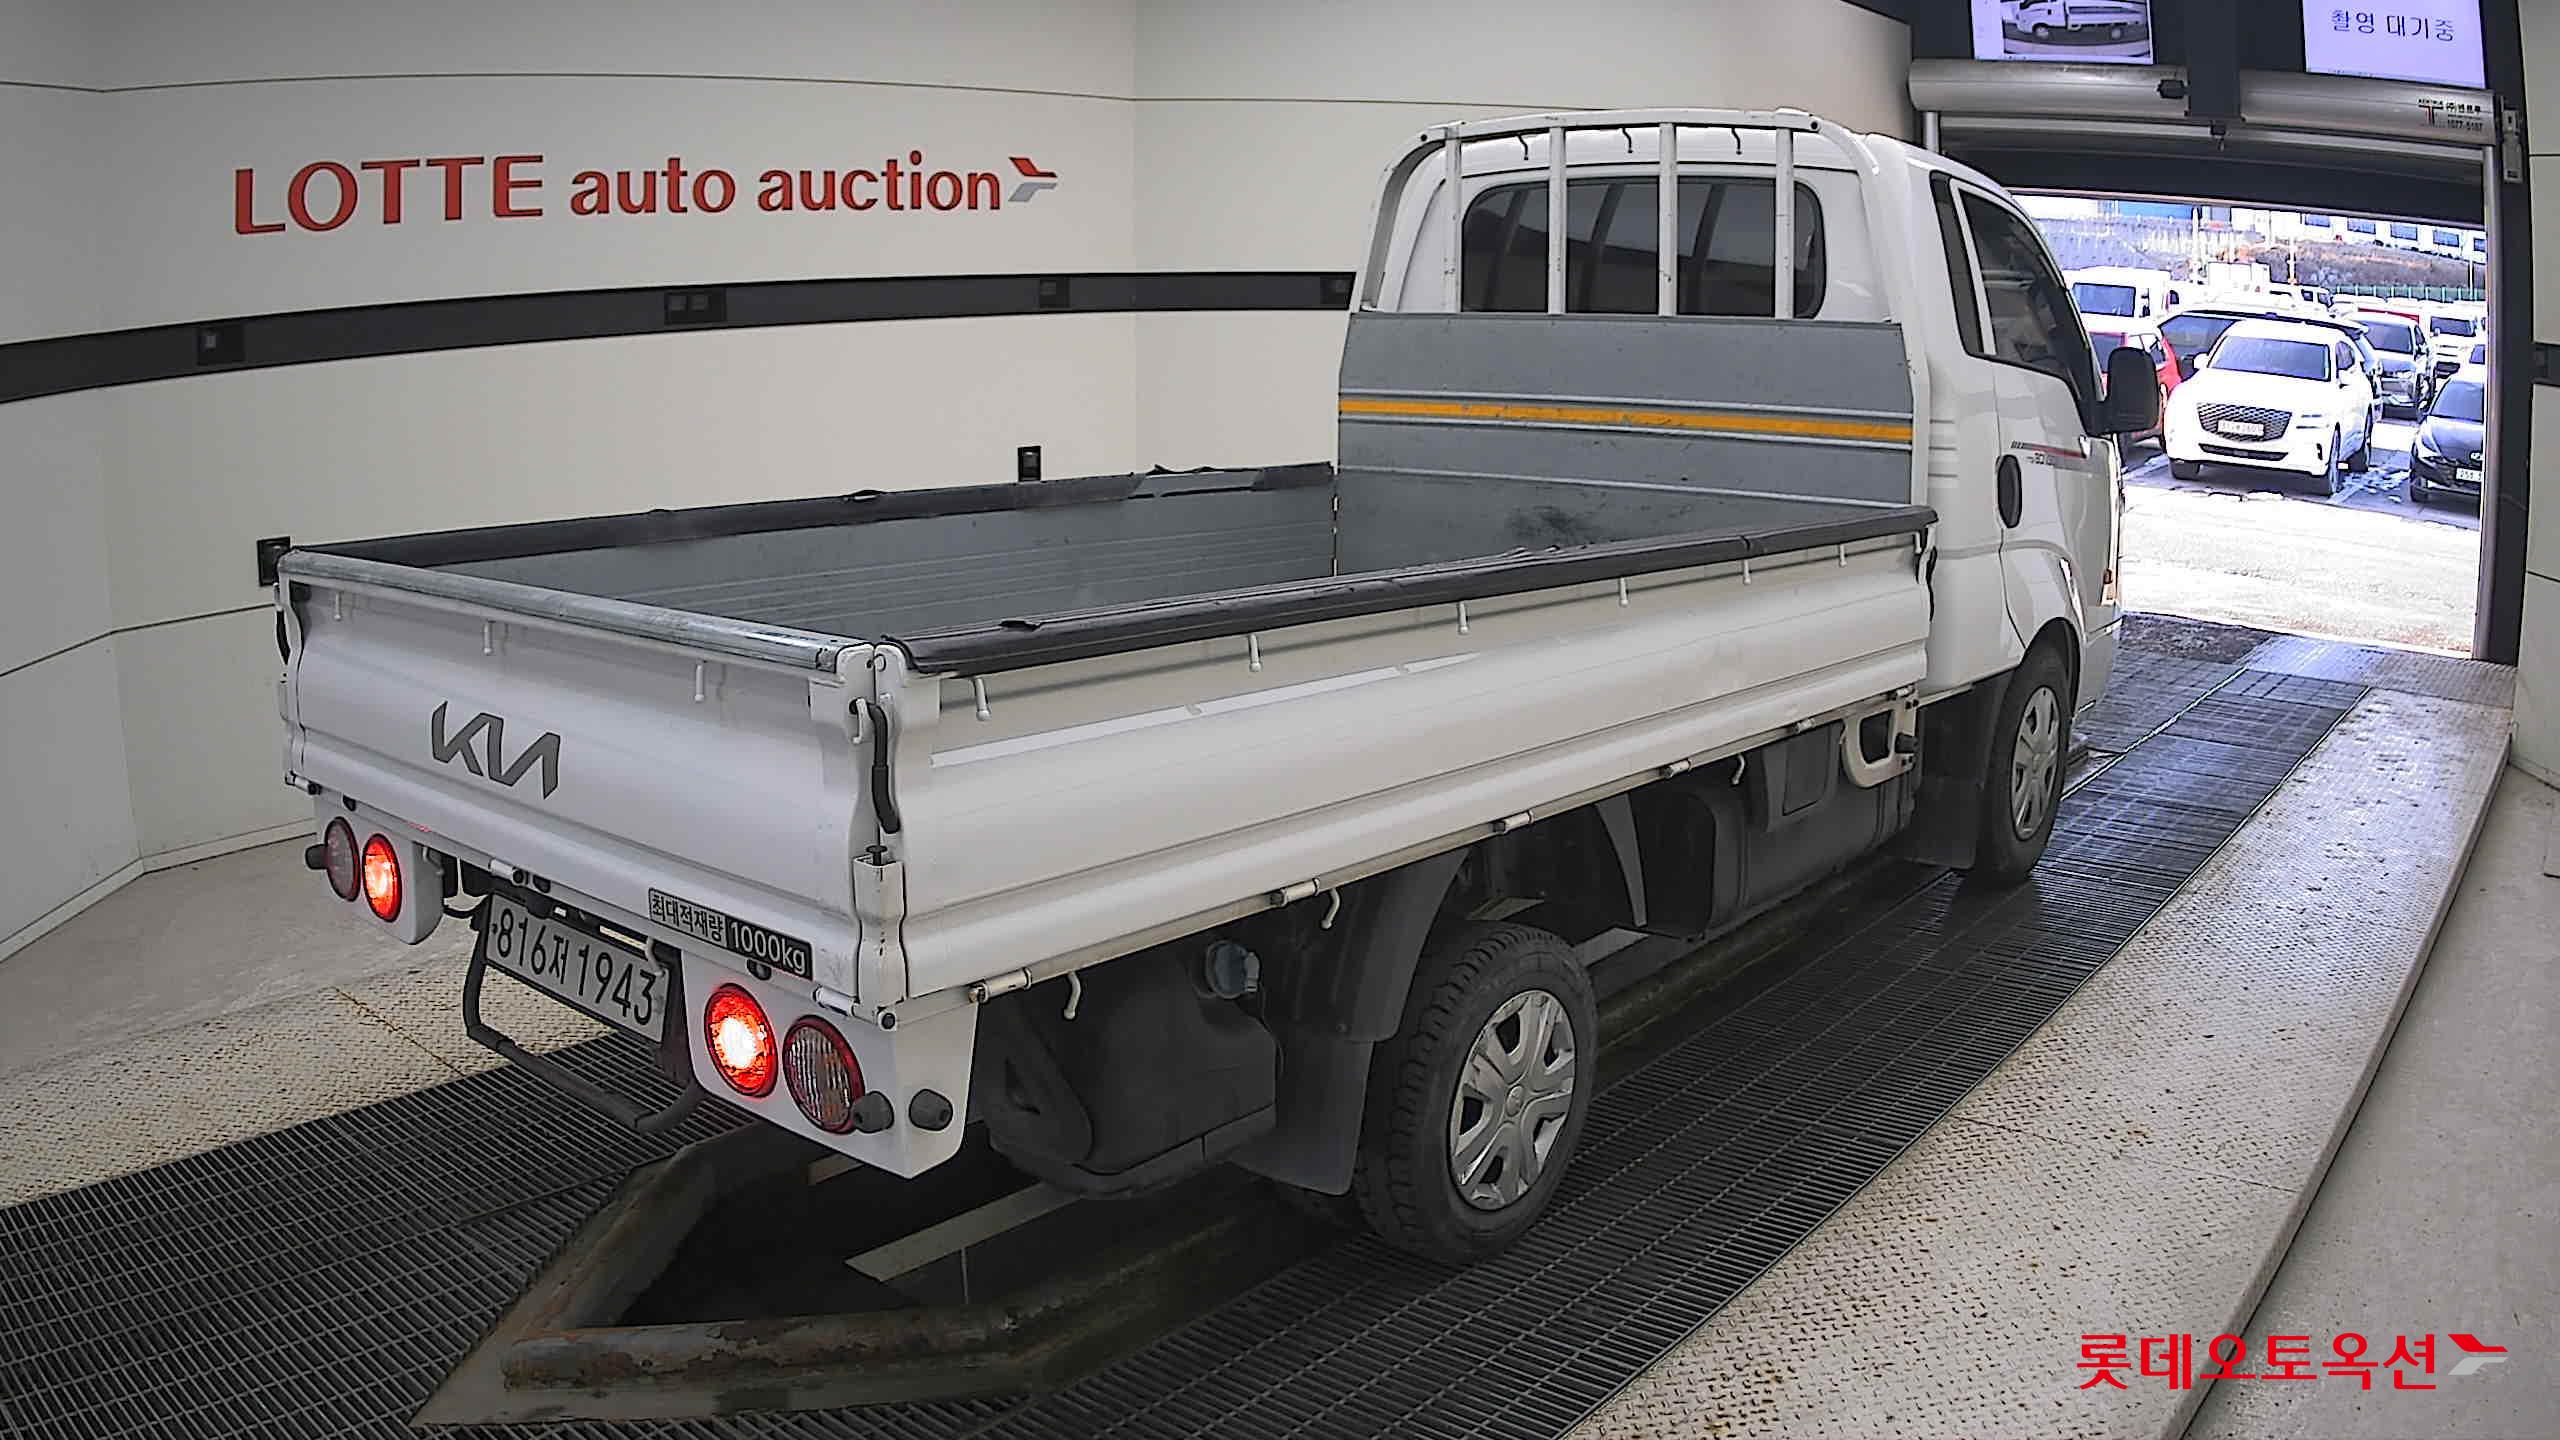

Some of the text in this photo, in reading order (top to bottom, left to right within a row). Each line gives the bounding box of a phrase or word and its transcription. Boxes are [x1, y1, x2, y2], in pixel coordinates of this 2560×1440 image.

[2332, 9, 2375, 34] 촬영
[235, 148, 1001, 234] LOTTE auto auction
[432, 700, 560, 799] KIA
[652, 893, 805, 975] 최대적재량 1000kg
